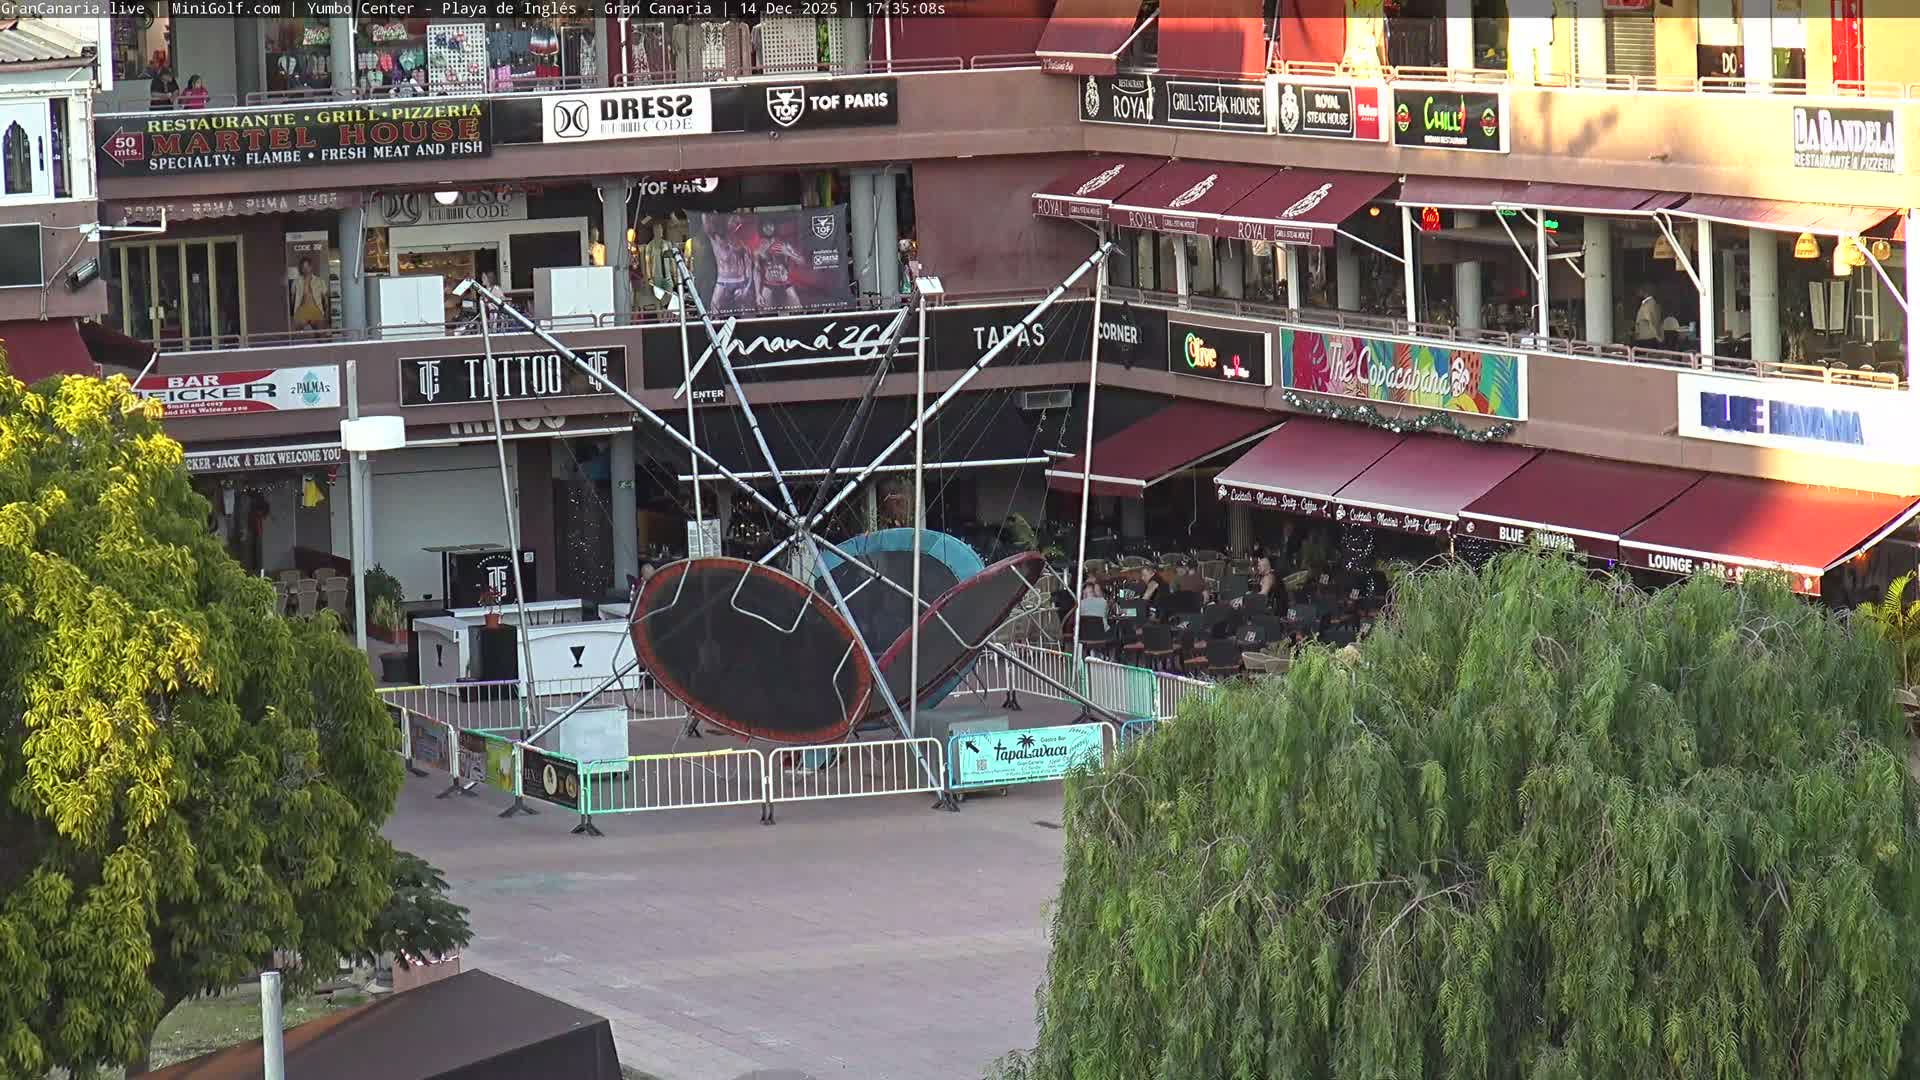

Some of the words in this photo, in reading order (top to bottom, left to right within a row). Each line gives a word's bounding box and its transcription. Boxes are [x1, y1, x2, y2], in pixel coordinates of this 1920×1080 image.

[809, 95, 841, 111] TOF
[844, 92, 889, 110] PARIS
[1113, 94, 1154, 120] ROYAL
[1230, 96, 1261, 116] HOUSE
[1314, 93, 1341, 110] ROYAL
[147, 113, 296, 133] RESTAURANTE
[317, 109, 379, 124] GRILL
[391, 103, 482, 121] PIZZERIA
[773, 104, 799, 118] TOF
[1306, 111, 1327, 125] STEAK
[1327, 113, 1349, 126] HOUSE
[642, 117, 694, 132] CODE
[115, 136, 137, 149] 50
[152, 127, 320, 157] MARTEL
[339, 119, 481, 146] HOUSE
[114, 148, 143, 157] mts.
[149, 154, 236, 171] SPECIALTY:
[245, 151, 301, 166] FLAMBE
[321, 146, 367, 161] FRESH
[373, 144, 410, 159] MEAT
[416, 142, 445, 156] AND
[451, 140, 483, 154] FISH
[639, 181, 668, 196] TOF
[465, 202, 511, 218] CODE
[1038, 200, 1064, 216] ROYAL
[1128, 211, 1158, 229] ROYAL
[815, 226, 831, 234] TOF
[1238, 222, 1268, 240] ROYAL
[973, 323, 1046, 350] TAPAS
[1098, 322, 1138, 345] CORNER
[464, 353, 562, 399] TATTOO
[1329, 341, 1354, 383] The
[1357, 345, 1452, 397] Copacabana
[167, 375, 220, 389] BAR
[692, 389, 724, 400] ENTER
[180, 408, 196, 416] Erik
[199, 406, 232, 414] Welcome
[191, 401, 206, 409] and
[215, 454, 241, 469] JACK
[253, 451, 276, 466] ERIK
[277, 448, 321, 464] WELCOME
[322, 447, 342, 461] YOU
[1499, 525, 1525, 543] BLUE
[1647, 552, 1693, 574] LOUNGE
